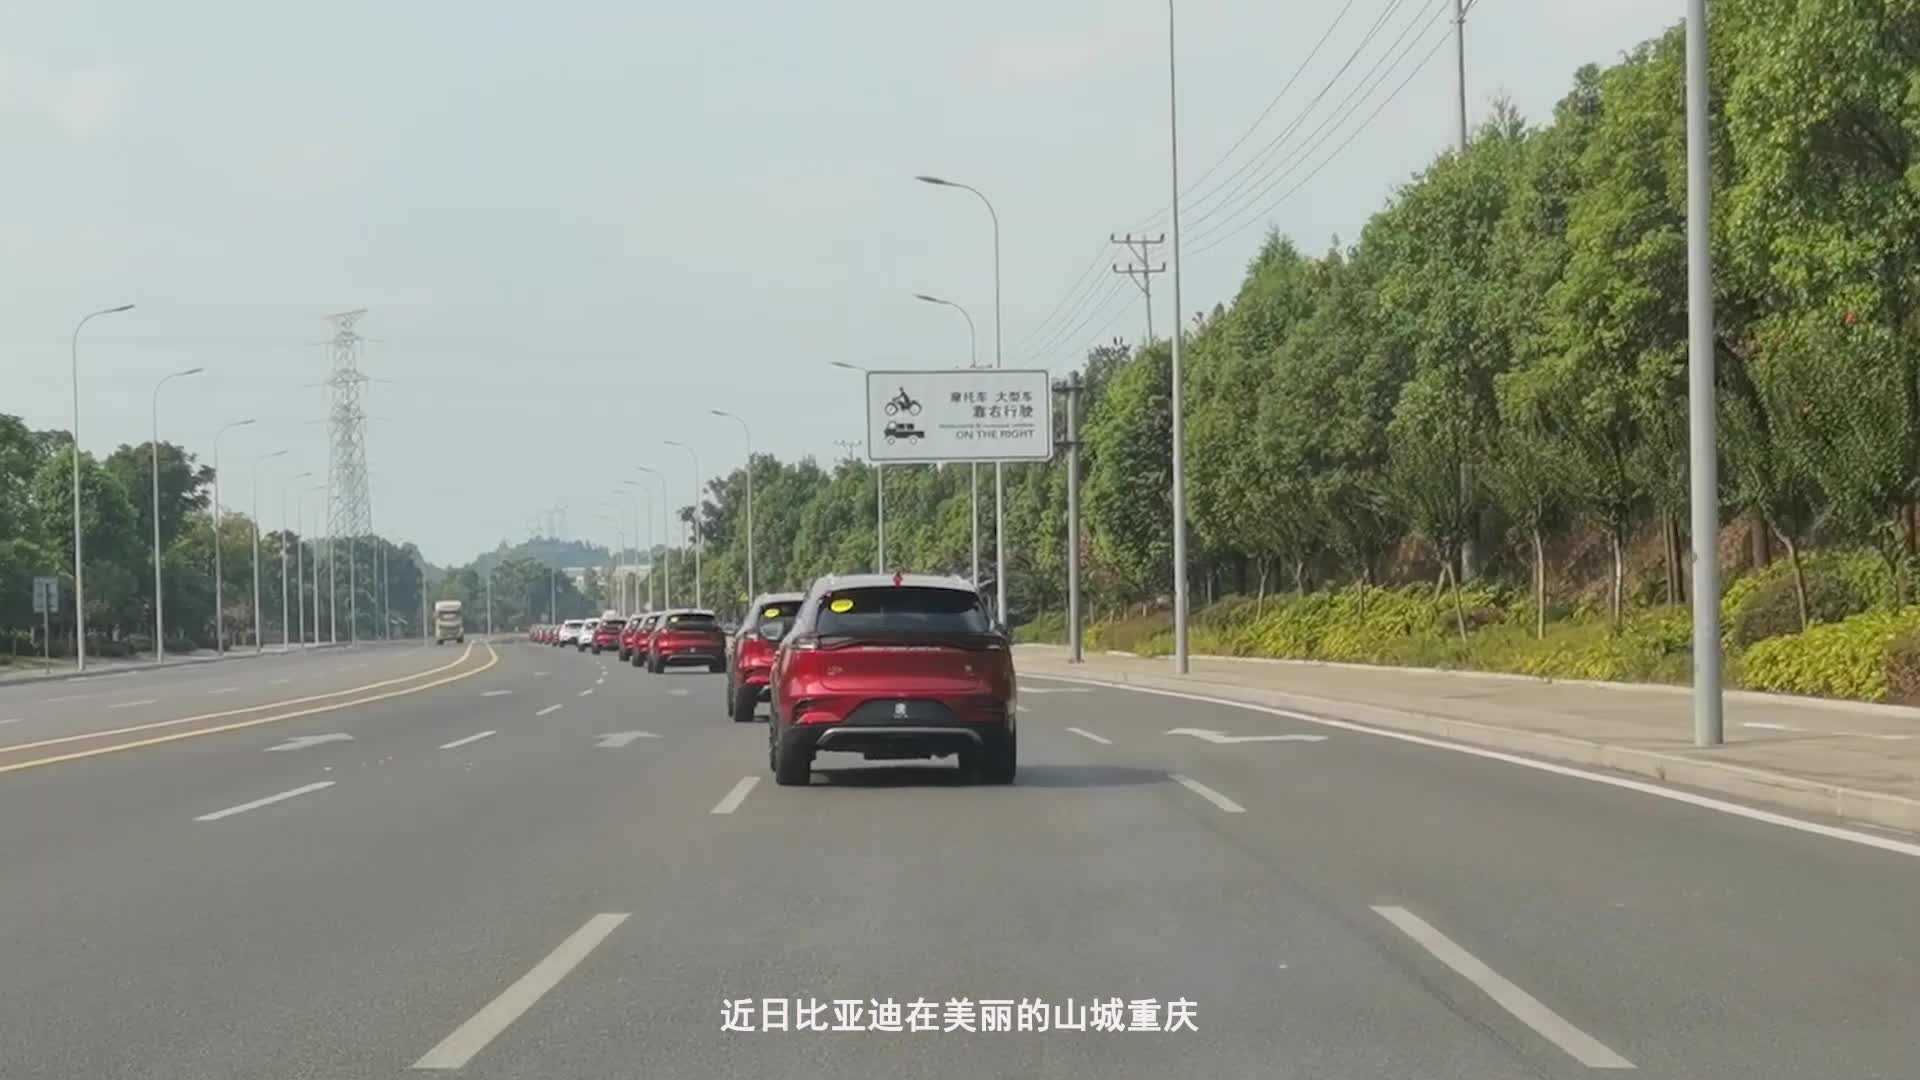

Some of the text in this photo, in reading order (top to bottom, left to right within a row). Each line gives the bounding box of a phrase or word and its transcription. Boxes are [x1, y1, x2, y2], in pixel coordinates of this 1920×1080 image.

[950, 391, 1033, 403] 摩托车 大型车
[973, 405, 1034, 418] 靠右行驶
[956, 429, 1035, 440] ON THE RIGHT
